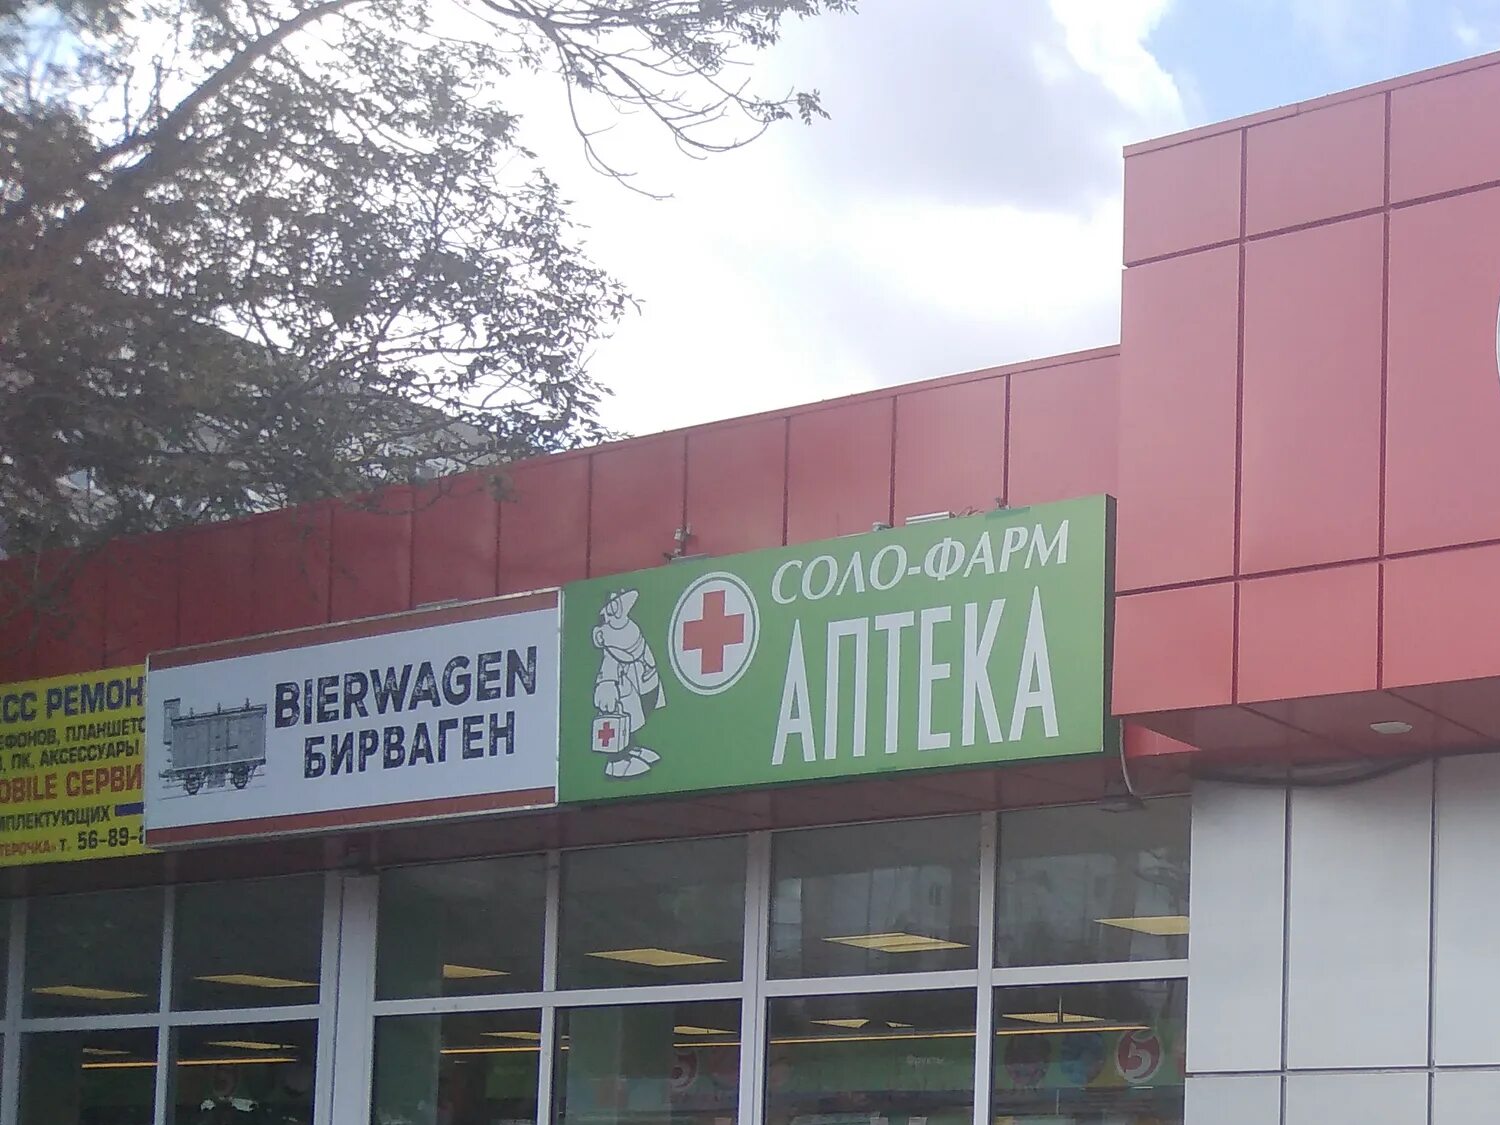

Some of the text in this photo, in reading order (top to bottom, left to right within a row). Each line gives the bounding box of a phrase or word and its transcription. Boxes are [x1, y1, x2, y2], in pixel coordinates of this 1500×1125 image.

[770, 519, 1070, 605] СОЛО-ФАРМ
[0, 675, 146, 725] СС РЕМОН
[274, 645, 538, 729] BIERWAGEN
[771, 585, 1060, 766] АПТЕКА
[304, 711, 515, 780] БИРВАГЕН
